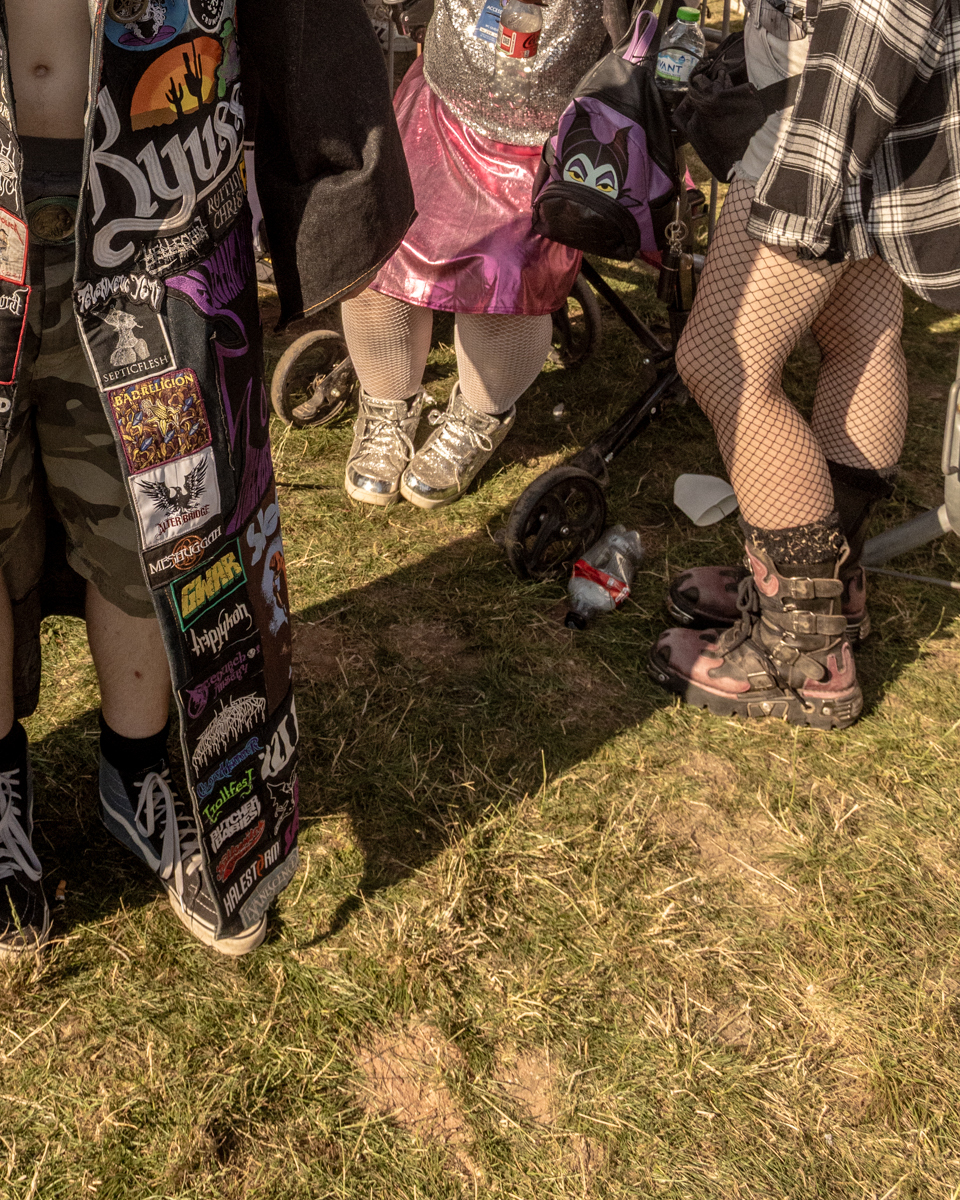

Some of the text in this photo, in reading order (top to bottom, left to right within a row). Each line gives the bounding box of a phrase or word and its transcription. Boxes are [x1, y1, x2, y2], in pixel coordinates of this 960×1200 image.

[208, 169, 243, 214] ROTTIN
[213, 196, 244, 229] CHRIS
[103, 355, 170, 383] SEPTICFLESH
[114, 374, 194, 406] BAD RELIGION
[155, 504, 209, 539] ALTER BRIDGE
[149, 525, 222, 575] MESHUGGAH
[180, 551, 243, 620] GWAR
[210, 794, 260, 838] BUTCHER
[211, 808, 261, 854] BABIES
[223, 841, 280, 917] HALESTORM
